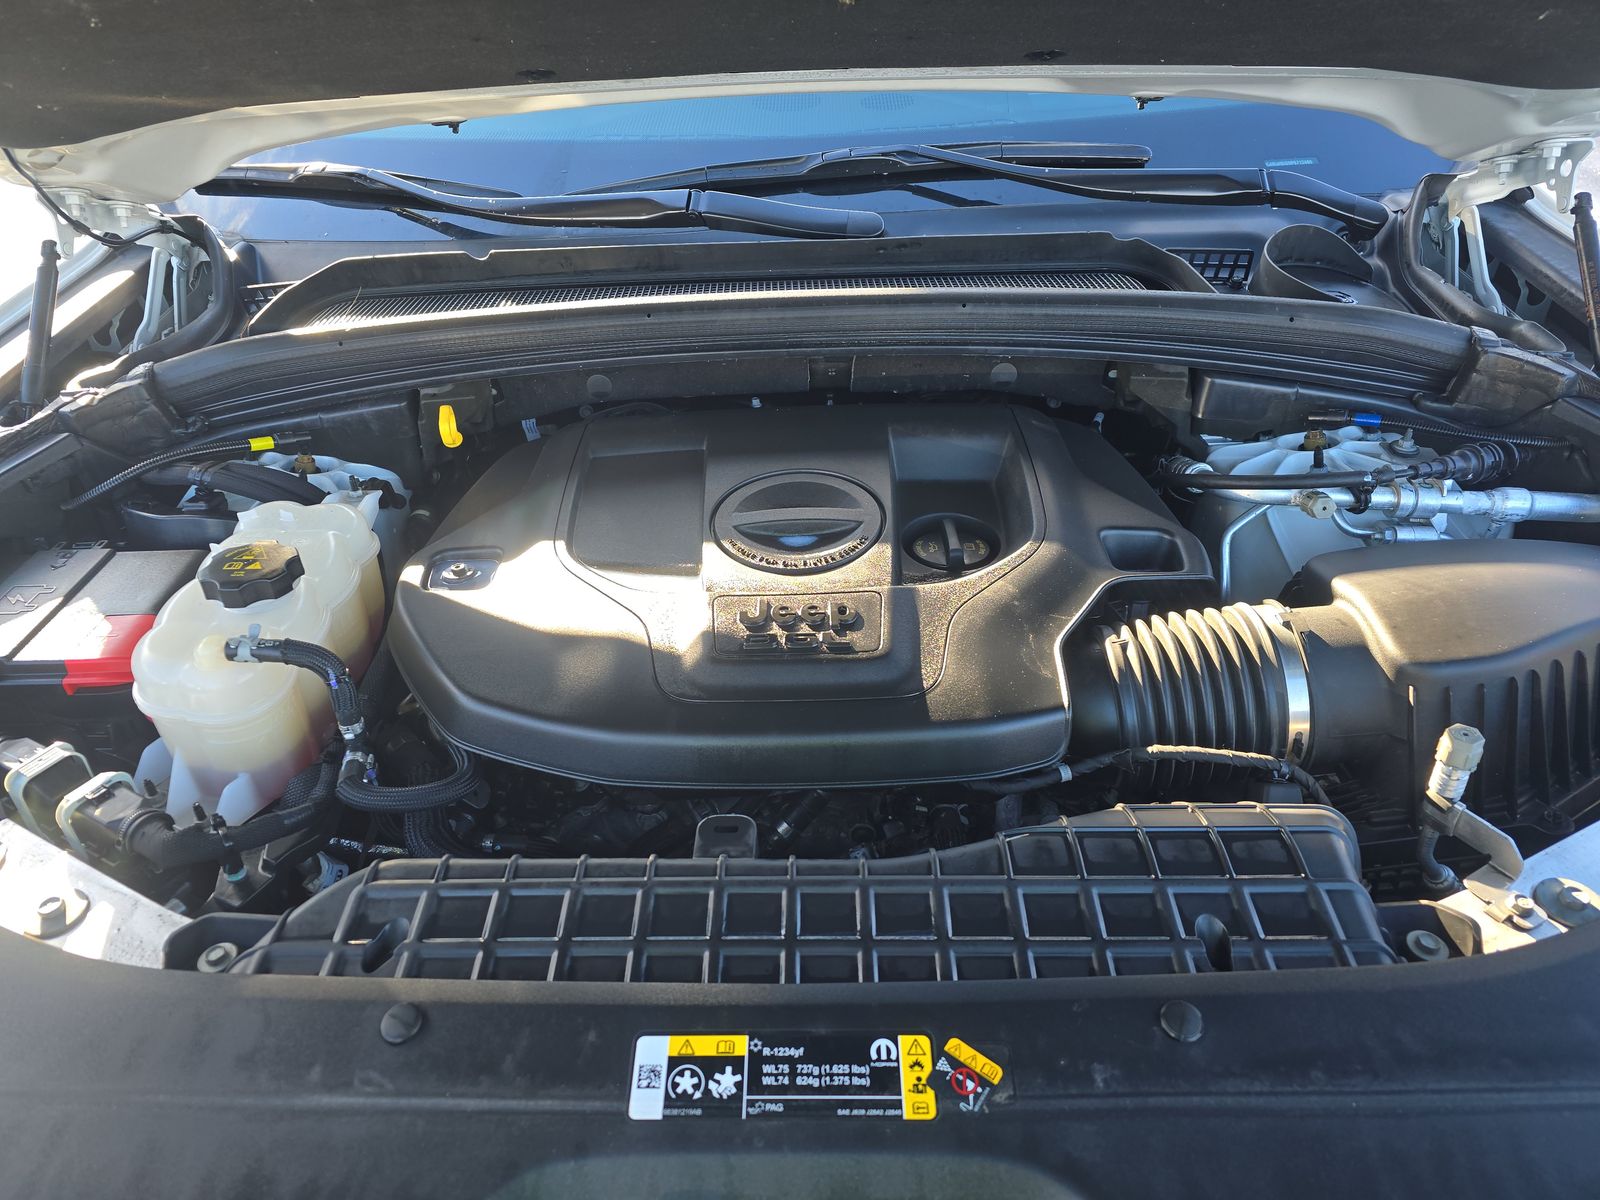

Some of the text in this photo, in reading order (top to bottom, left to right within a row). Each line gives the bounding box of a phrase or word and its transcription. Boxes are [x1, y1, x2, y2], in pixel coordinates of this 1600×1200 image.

[737, 597, 857, 631] Jeep
[762, 1046, 805, 1059] R-1234yf
[795, 1063, 820, 1076] 737g
[851, 1063, 870, 1076] lbs)
[762, 1075, 790, 1086] WL74
[821, 1075, 851, 1088] (1.375
[851, 1075, 870, 1088] lbs)
[765, 1102, 785, 1113] PAG
